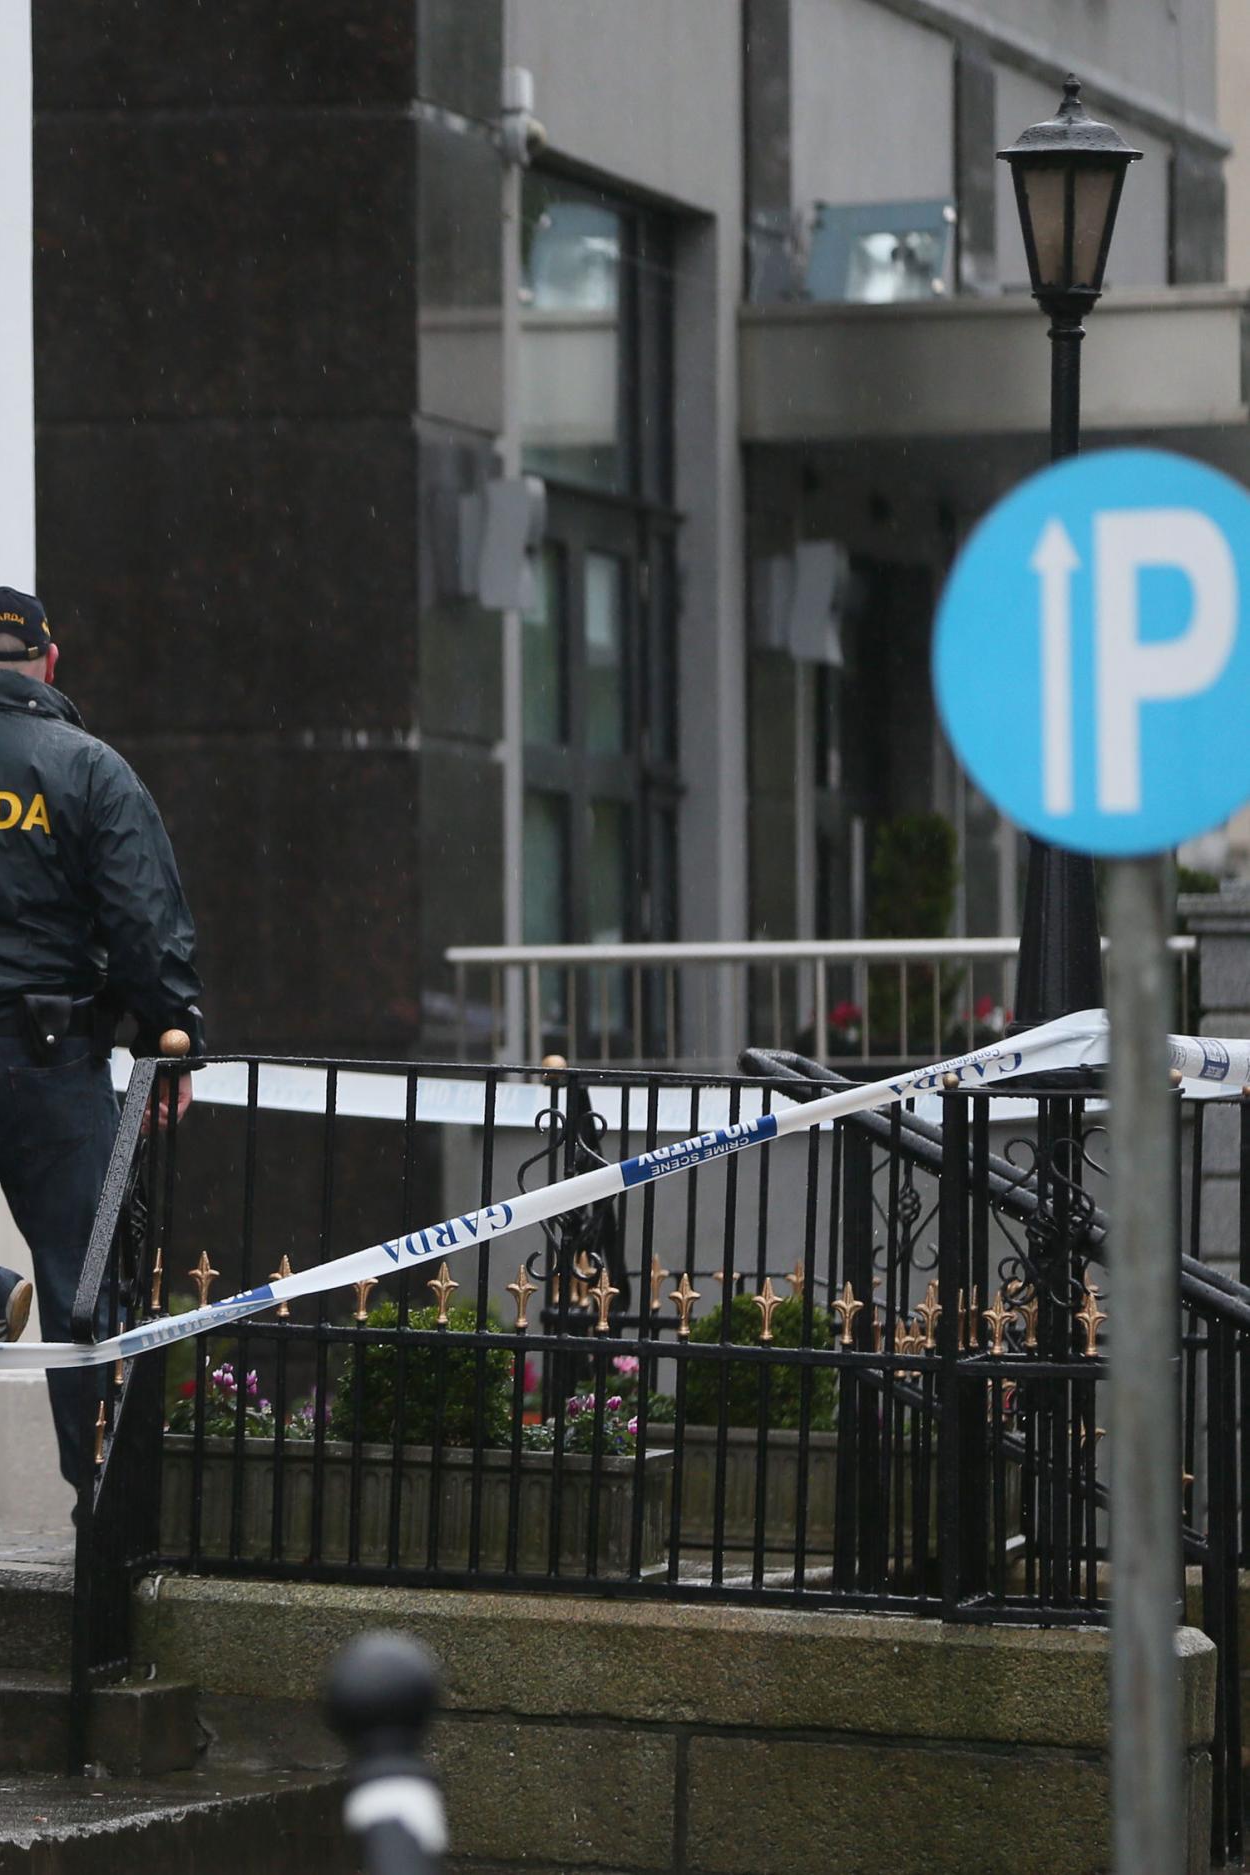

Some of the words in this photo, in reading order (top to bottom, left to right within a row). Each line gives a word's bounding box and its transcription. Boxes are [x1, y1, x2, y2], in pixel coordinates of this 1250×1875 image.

[1093, 506, 1240, 814] P
[725, 1119, 759, 1139] NO
[704, 1138, 750, 1158] CRIME
[651, 1152, 700, 1176] SCENE
[381, 1203, 513, 1264] GARDA
